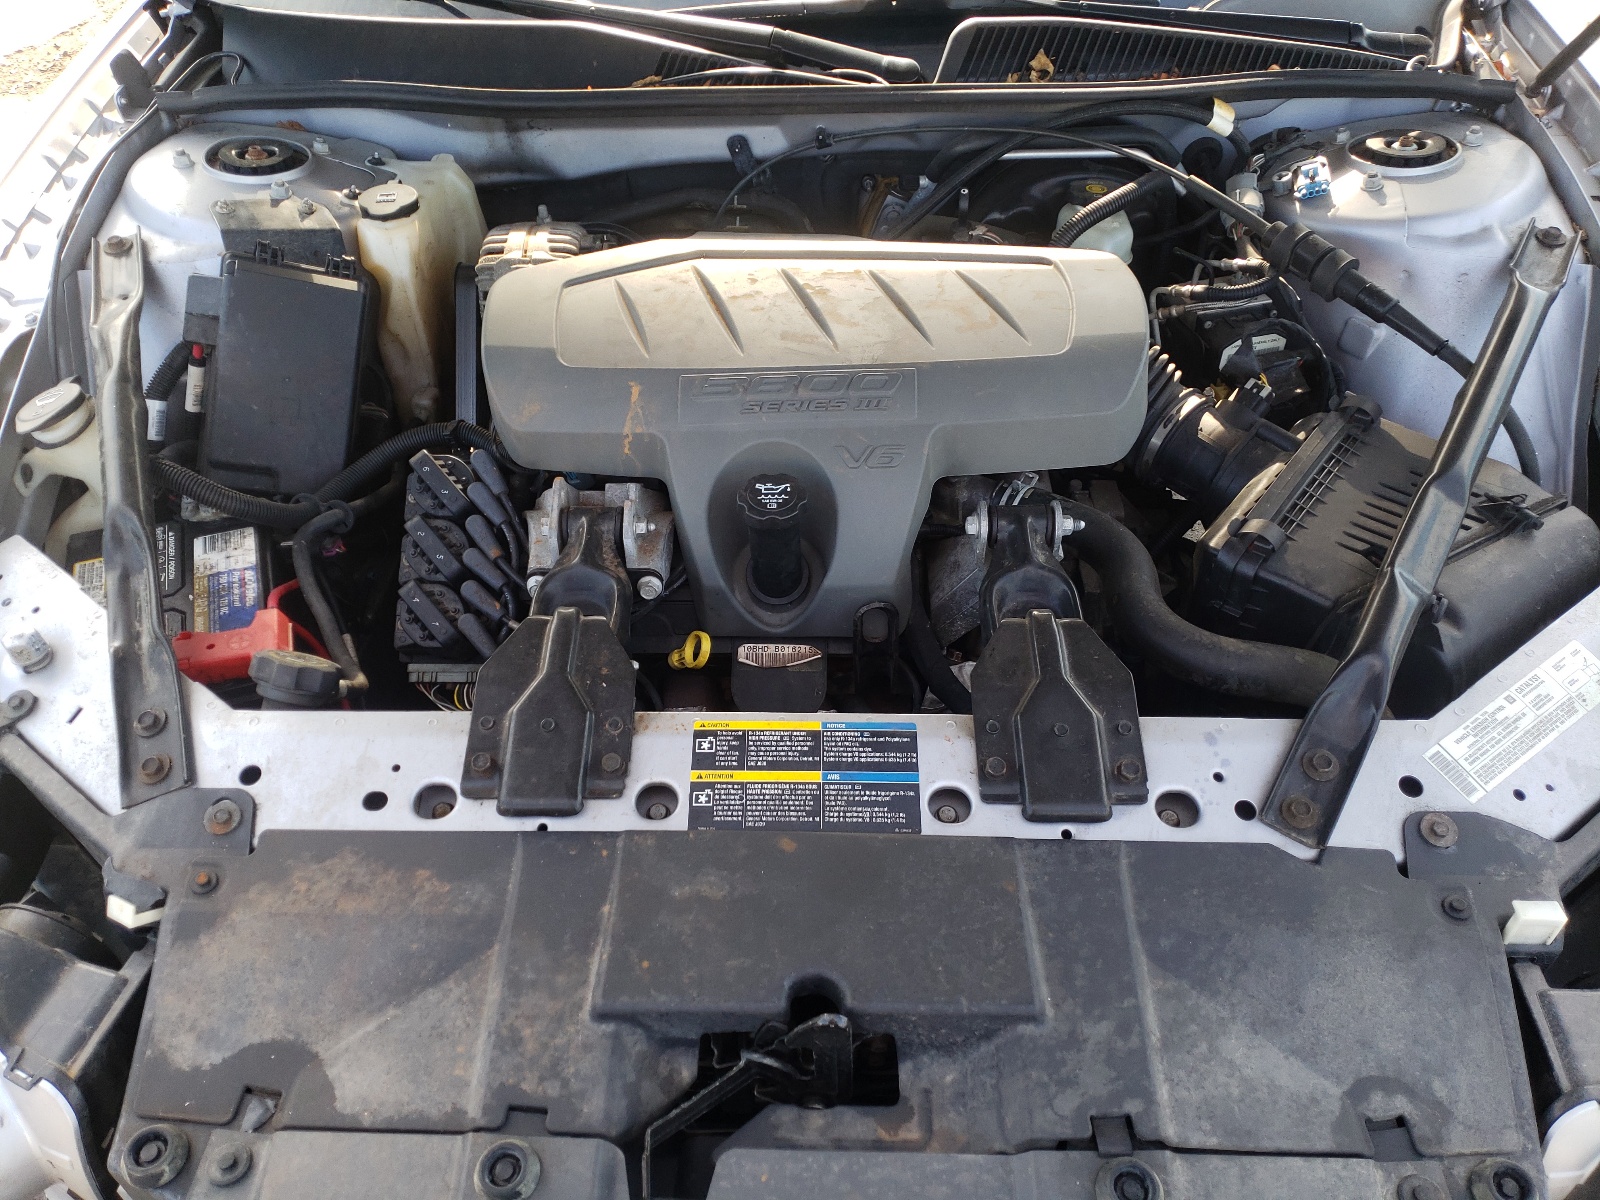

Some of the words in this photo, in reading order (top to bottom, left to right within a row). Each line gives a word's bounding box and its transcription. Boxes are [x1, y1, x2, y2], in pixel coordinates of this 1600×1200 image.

[691, 372, 902, 400] 3800
[740, 397, 848, 414] SERIES
[853, 397, 892, 411] III
[834, 444, 906, 469] V6
[1514, 673, 1541, 695] CATALYST
[1453, 730, 1471, 744] VEHICLE
[1487, 704, 1506, 719] CONTROL
